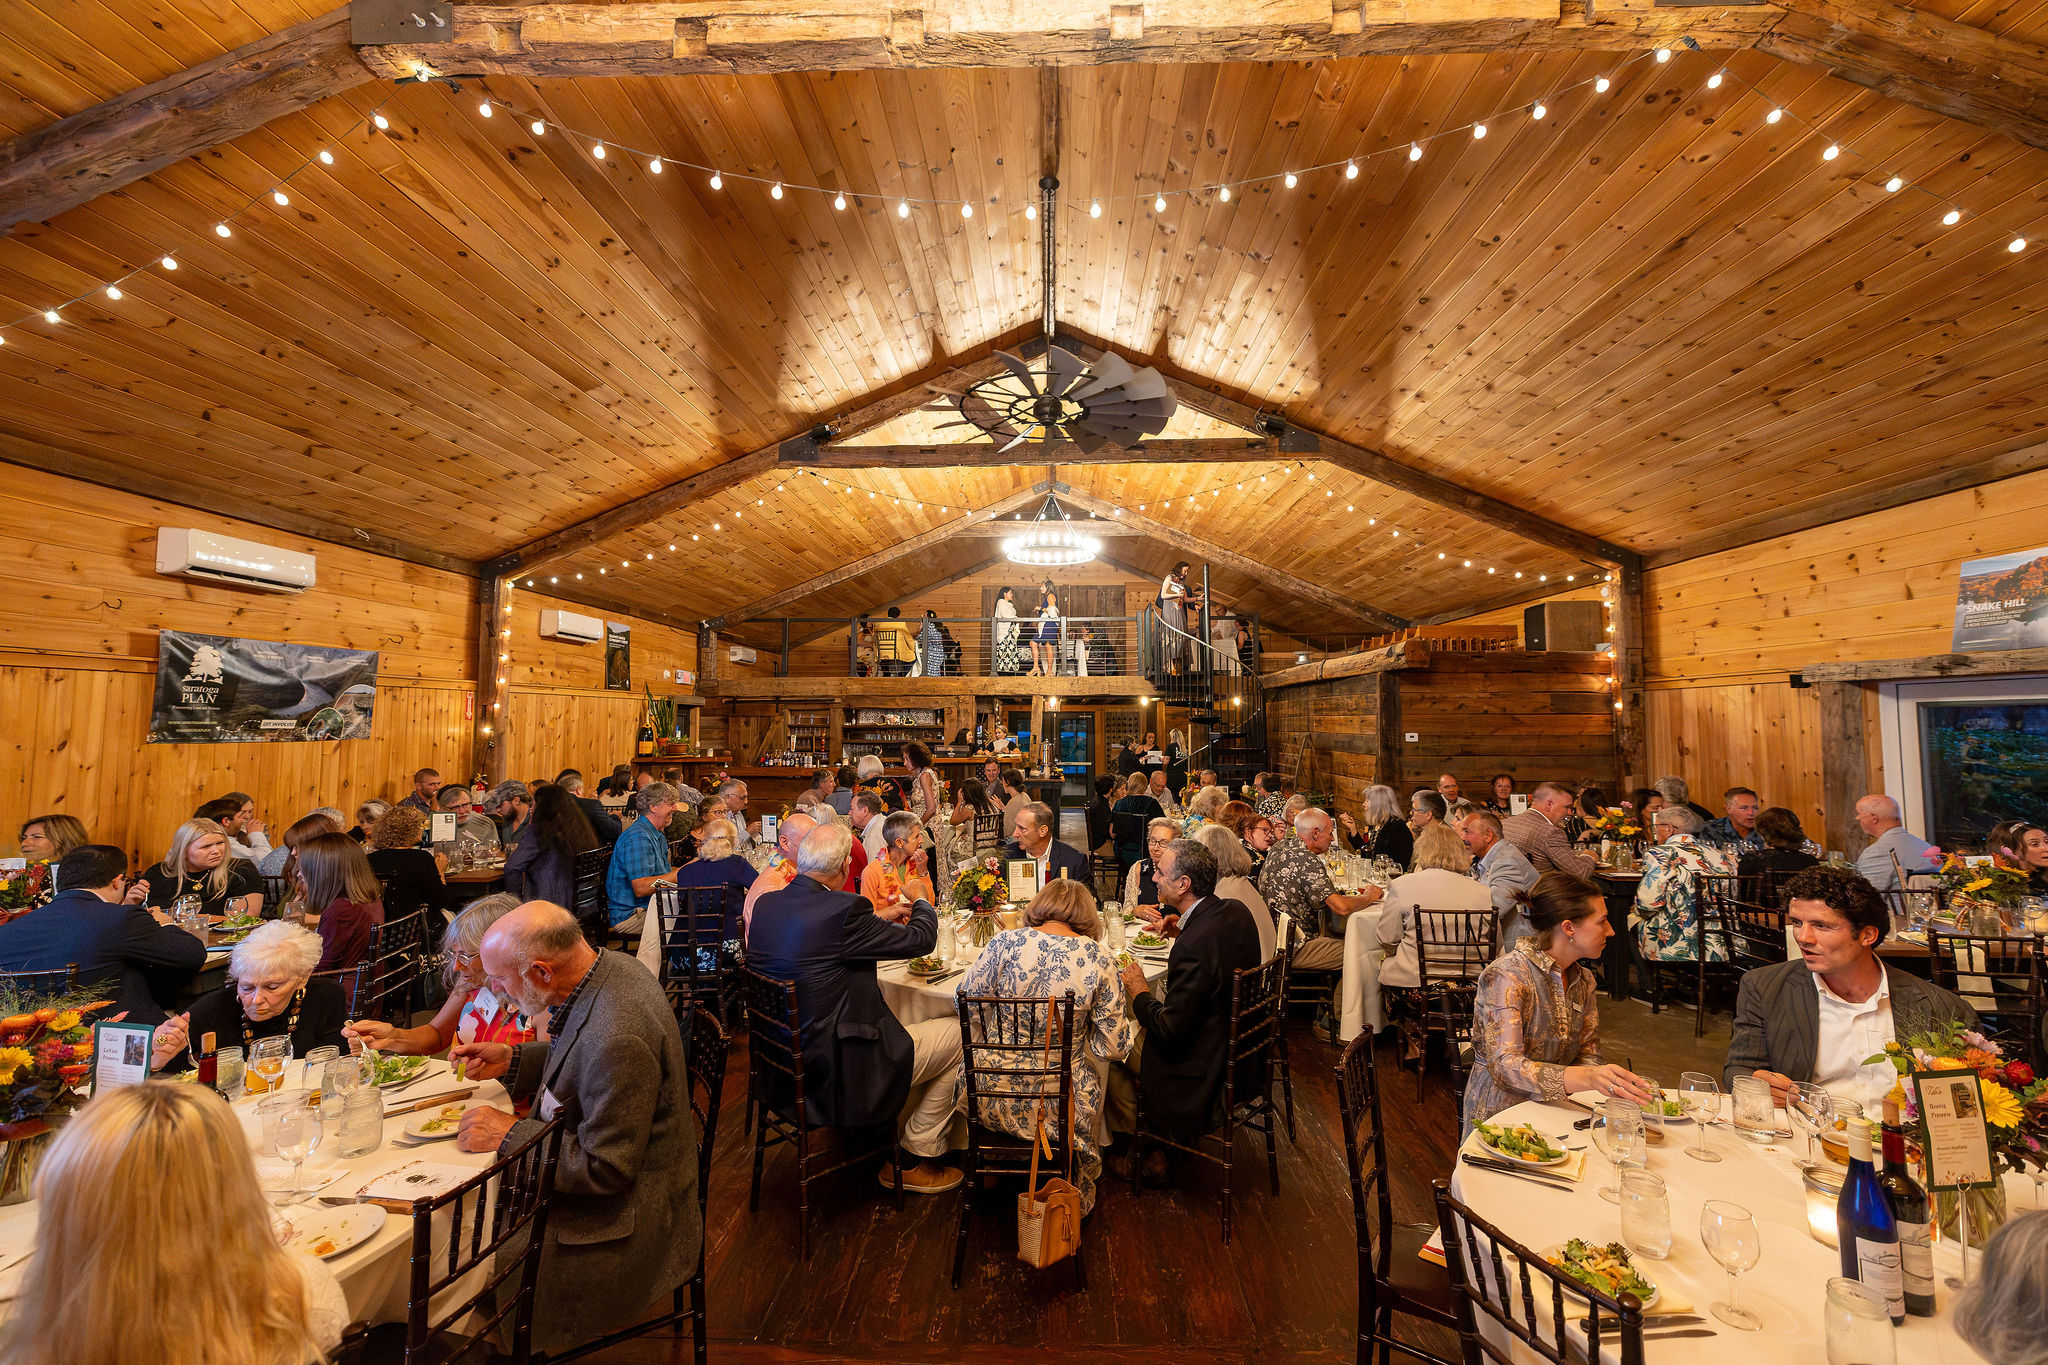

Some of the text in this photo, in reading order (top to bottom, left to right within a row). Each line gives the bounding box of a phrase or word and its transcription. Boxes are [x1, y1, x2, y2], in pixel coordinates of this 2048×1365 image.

[1966, 598, 2026, 613] SNAKE HILL
[182, 685, 220, 694] saratoga
[181, 693, 217, 704] PLAN
